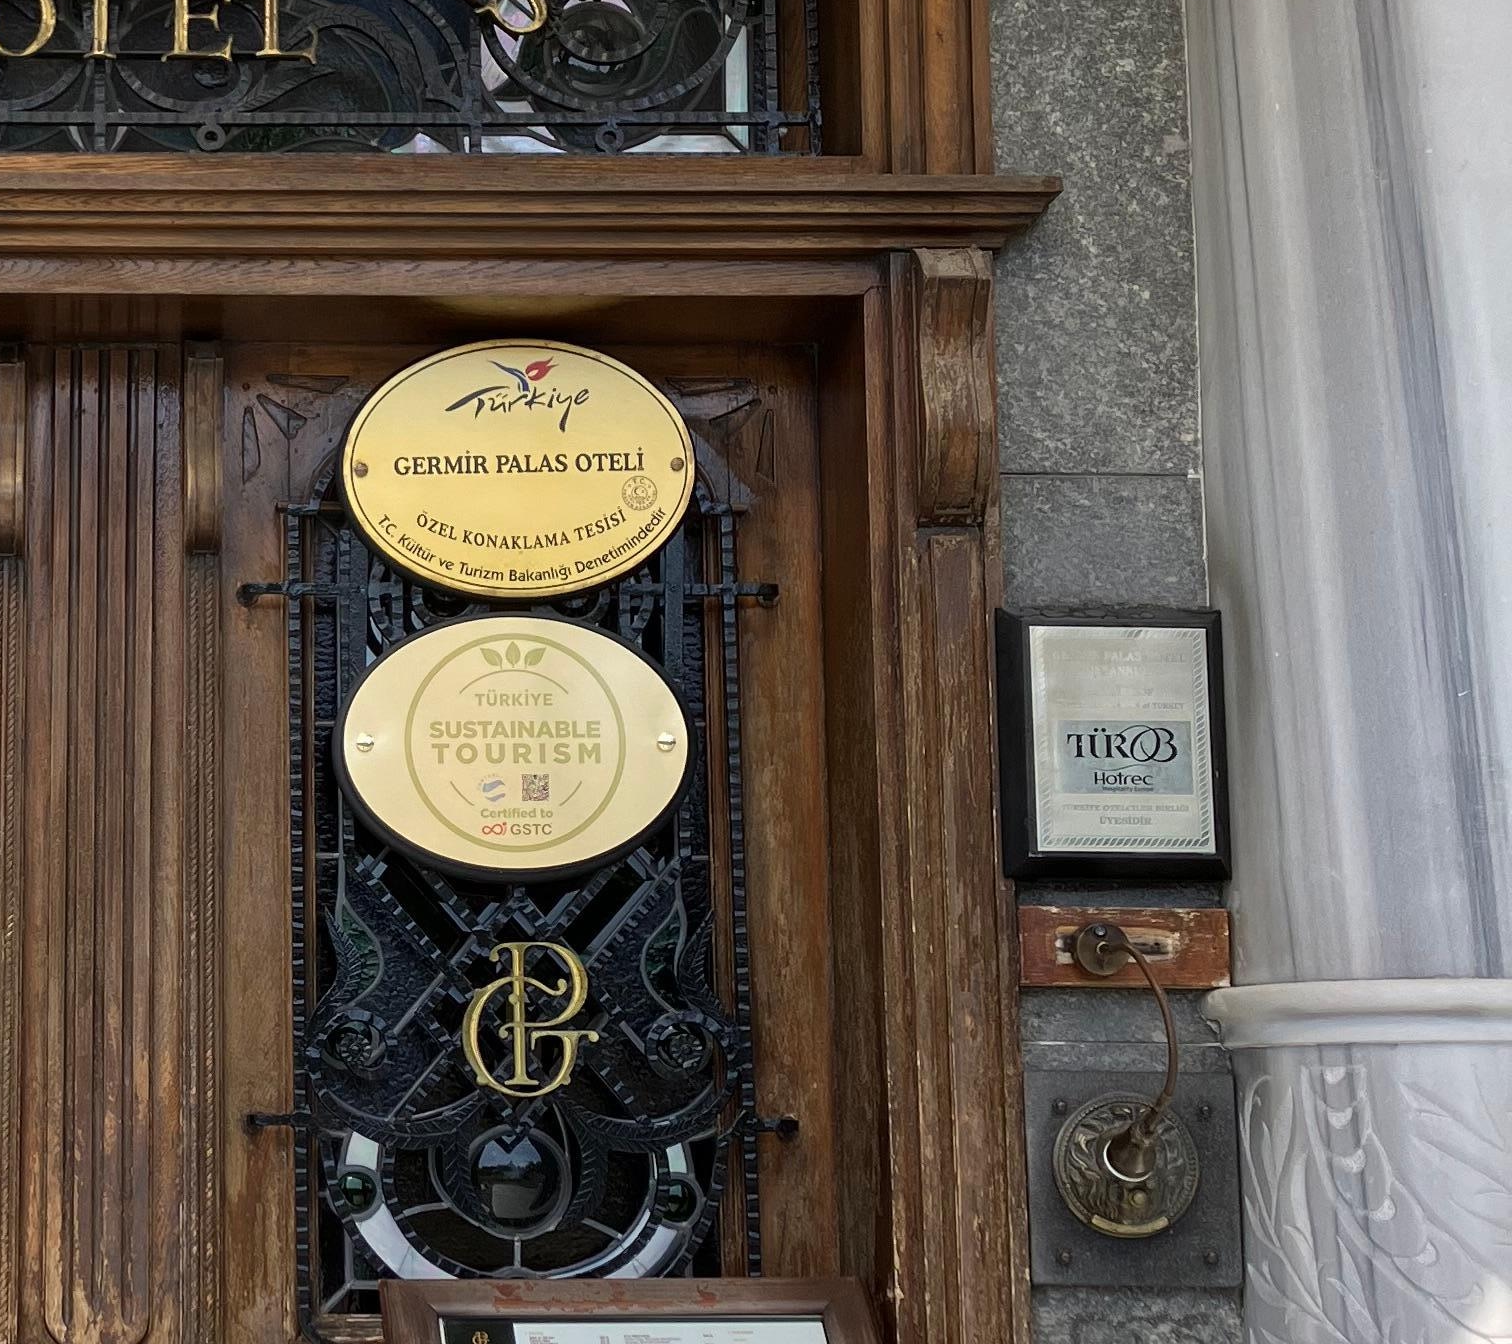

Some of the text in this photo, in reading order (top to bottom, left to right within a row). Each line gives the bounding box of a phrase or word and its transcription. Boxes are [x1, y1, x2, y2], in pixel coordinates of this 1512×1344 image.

[444, 385, 590, 433] Türkiye
[394, 446, 644, 475] GERMİR PALAS OTELİ
[416, 506, 627, 550] ÖZEL KONAKLAMA TESİSİ
[378, 507, 667, 581] T.C. Kültür ve Turizm Bakanlığı Denetimindedir
[474, 689, 553, 706] TÜRKİYE
[429, 720, 601, 739] SUSTAINABLE
[431, 742, 601, 764] TOURISM
[1094, 771, 1153, 786] Hotrec
[480, 808, 553, 819] Certified to
[510, 823, 553, 836] GSTC
